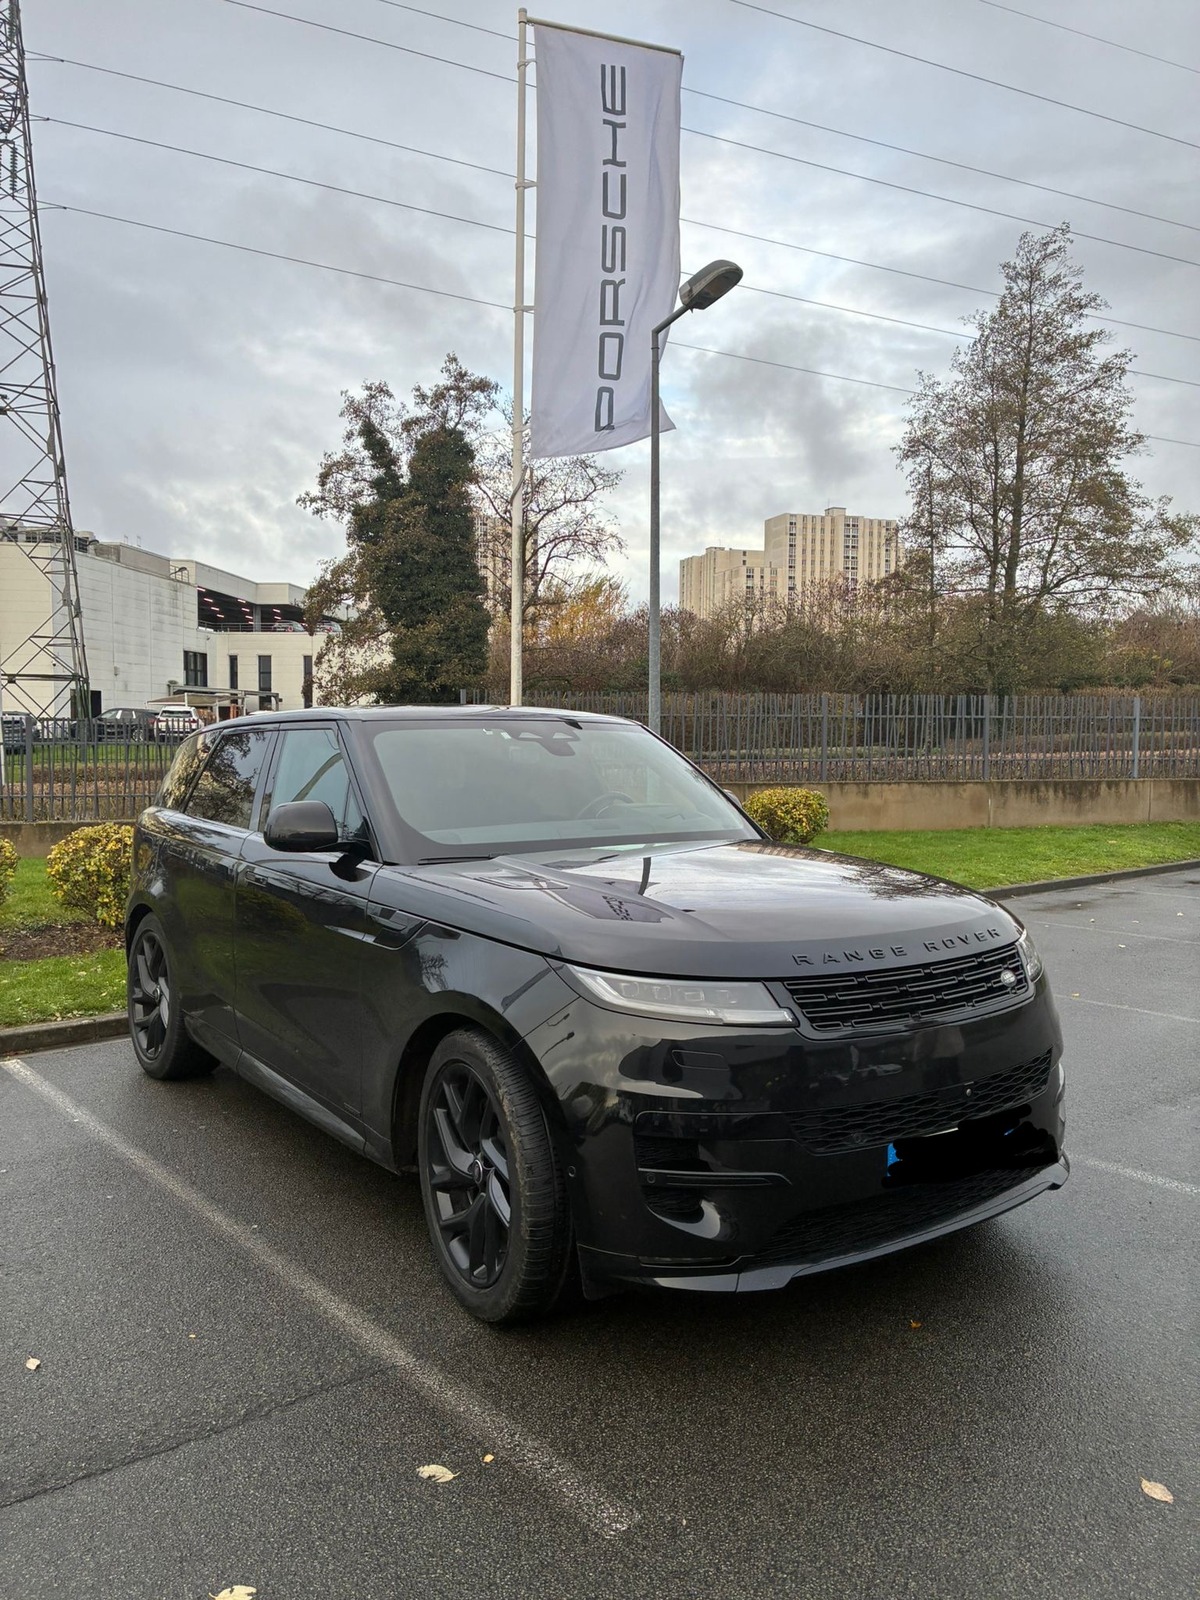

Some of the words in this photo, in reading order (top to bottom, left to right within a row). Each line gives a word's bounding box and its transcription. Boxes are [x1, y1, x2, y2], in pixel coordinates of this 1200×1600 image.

[594, 63, 627, 432] PORSCHE
[791, 944, 908, 966] RANGE
[923, 927, 1001, 953] ROVER
